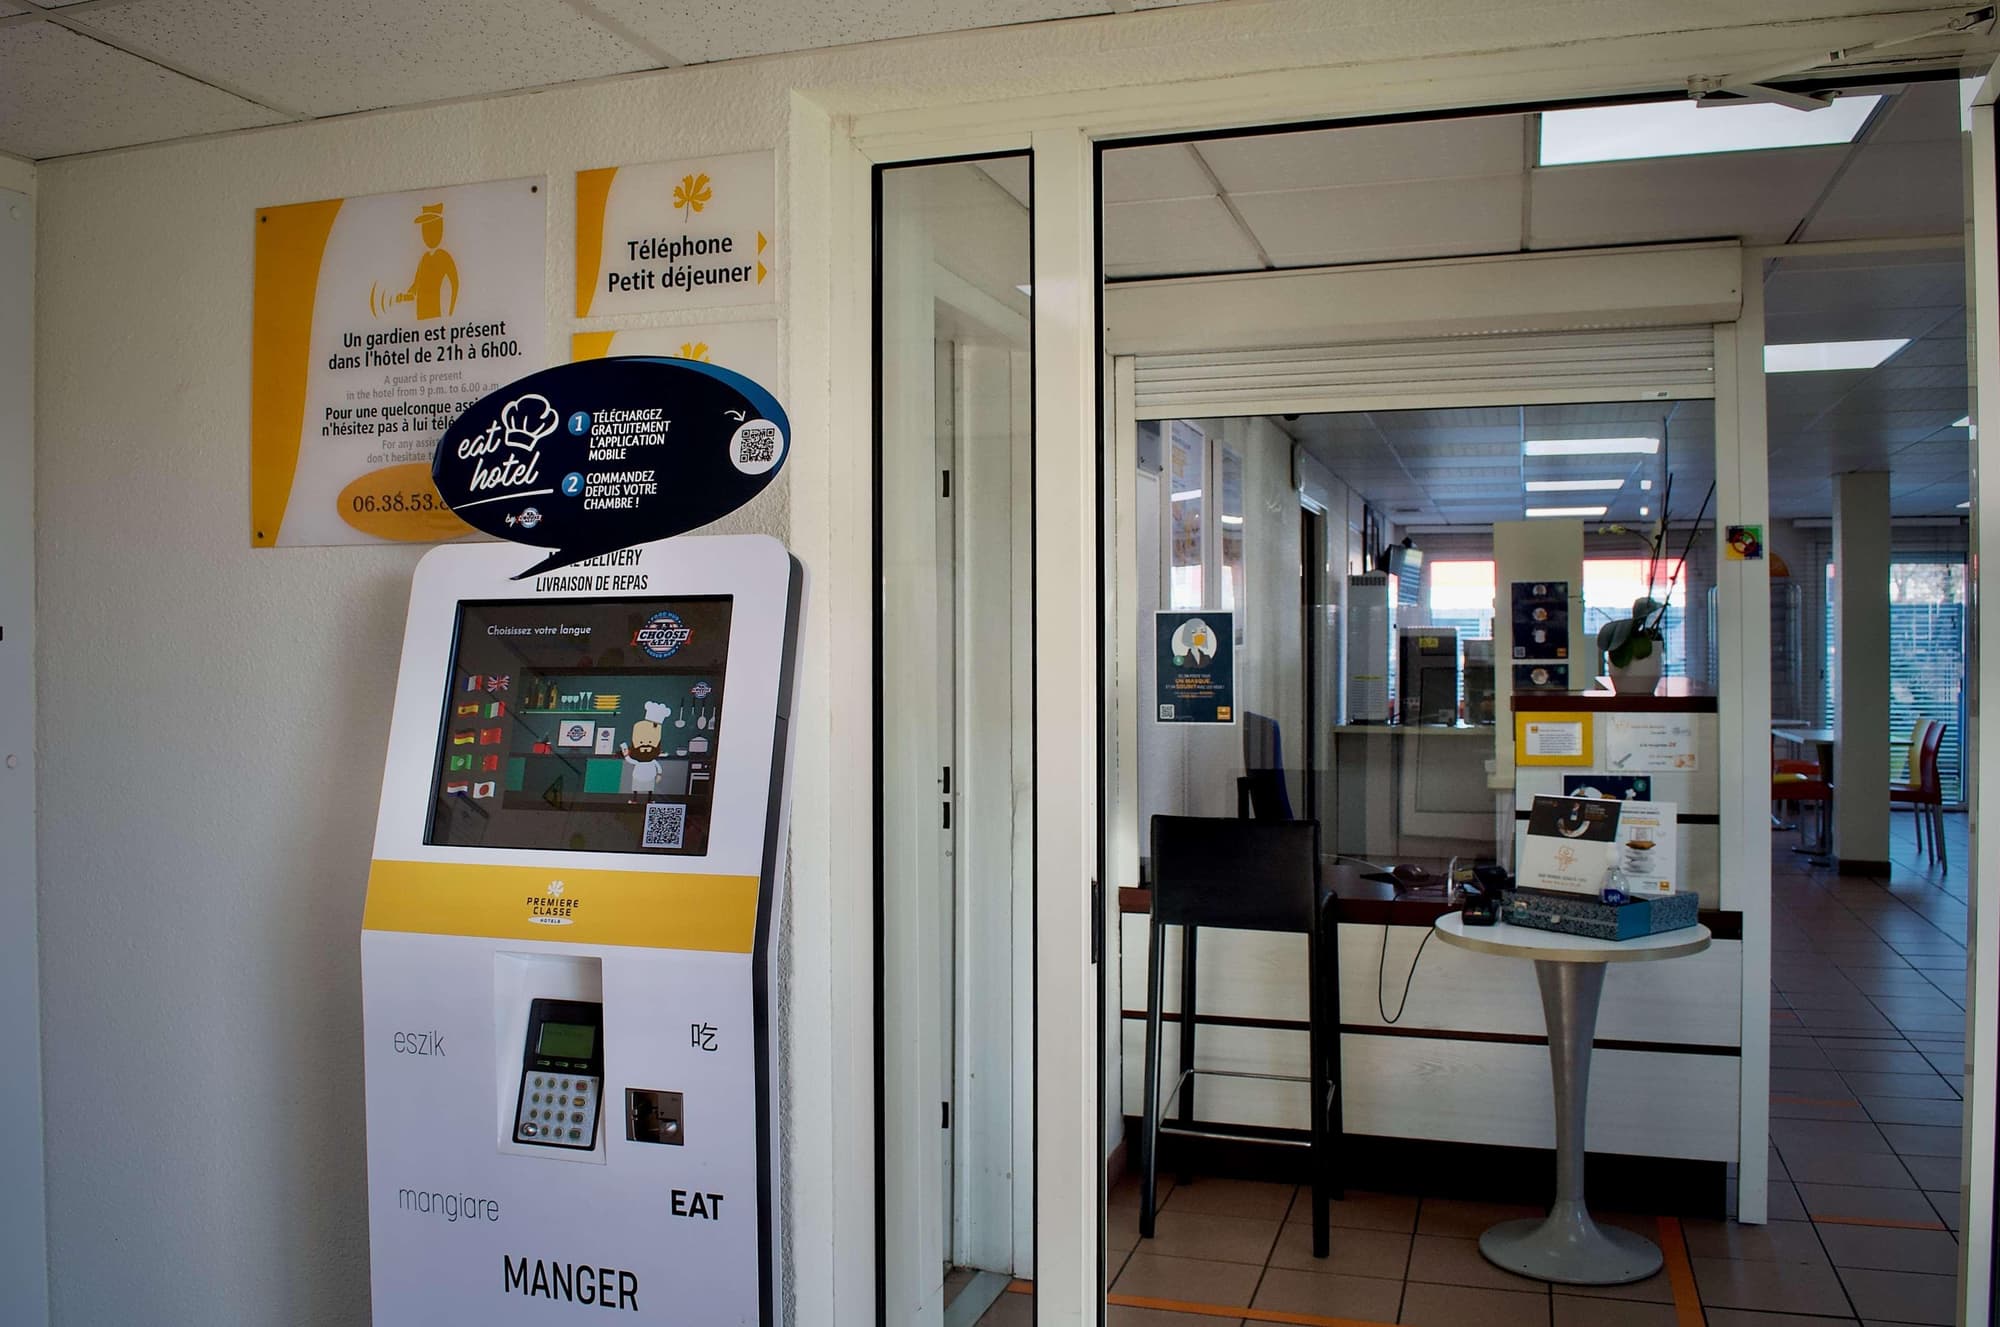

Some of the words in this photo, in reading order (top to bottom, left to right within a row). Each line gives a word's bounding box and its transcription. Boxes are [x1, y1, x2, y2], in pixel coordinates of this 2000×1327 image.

[627, 234, 733, 263] Téléphone
[608, 269, 655, 292] Petit
[661, 265, 752, 292] déjeuner
[343, 333, 361, 348] Un
[366, 328, 419, 350] gardien
[424, 326, 445, 341] est
[450, 321, 506, 344] présent
[329, 354, 360, 369] dans
[365, 349, 409, 367] l'hôtel
[414, 347, 432, 363] de
[437, 344, 463, 361] 21h
[468, 344, 476, 359] à
[481, 341, 522, 358] 6h00.
[384, 376, 391, 385] A
[392, 373, 417, 387] guard
[420, 373, 427, 382] is
[429, 371, 462, 384] present
[346, 391, 354, 400] in
[357, 389, 370, 399] the
[372, 387, 395, 399] hotel
[397, 386, 417, 397] from
[420, 386, 425, 396] 9
[427, 385, 447, 398] p.m.
[449, 384, 459, 394] to
[461, 382, 480, 393] 6.00
[326, 407, 353, 420] Pour
[356, 408, 377, 419] une
[381, 402, 451, 419] quelconque
[575, 415, 583, 432] 1
[592, 408, 663, 423] TÉLÉCHARGEZ
[322, 421, 374, 436] n'hésitez
[377, 422, 398, 436] pas
[402, 418, 409, 432] à
[413, 417, 428, 431] lui
[591, 420, 671, 436] GRATUITEMENT
[383, 439, 396, 449] For
[397, 440, 413, 450] any
[458, 420, 501, 460] eat
[589, 433, 665, 449] L'APPLICATION
[367, 453, 389, 464] don't
[391, 451, 426, 462] hesitate
[588, 448, 627, 461] MOBILE
[470, 451, 540, 492] hotel
[567, 476, 578, 493] 2
[586, 470, 655, 485] COMMANDEZ
[585, 484, 620, 497] DEPUIS
[623, 483, 658, 496] VOTRE
[583, 497, 634, 511] CHAMBRE
[536, 575, 593, 592] LIVRAISON
[595, 575, 611, 591] DE
[612, 574, 649, 591] REPAS
[487, 624, 533, 636] Choisissez
[534, 626, 558, 635] votre
[559, 623, 592, 636] langue
[639, 630, 688, 640] CHOOSE
[526, 897, 580, 908] PREMIERE
[533, 906, 572, 917] CLASSE
[394, 1029, 446, 1057] eszik
[691, 1023, 719, 1052] 吃
[399, 1187, 500, 1222] mangiare
[671, 1189, 724, 1221] EAT
[503, 1254, 639, 1311] MANGER
